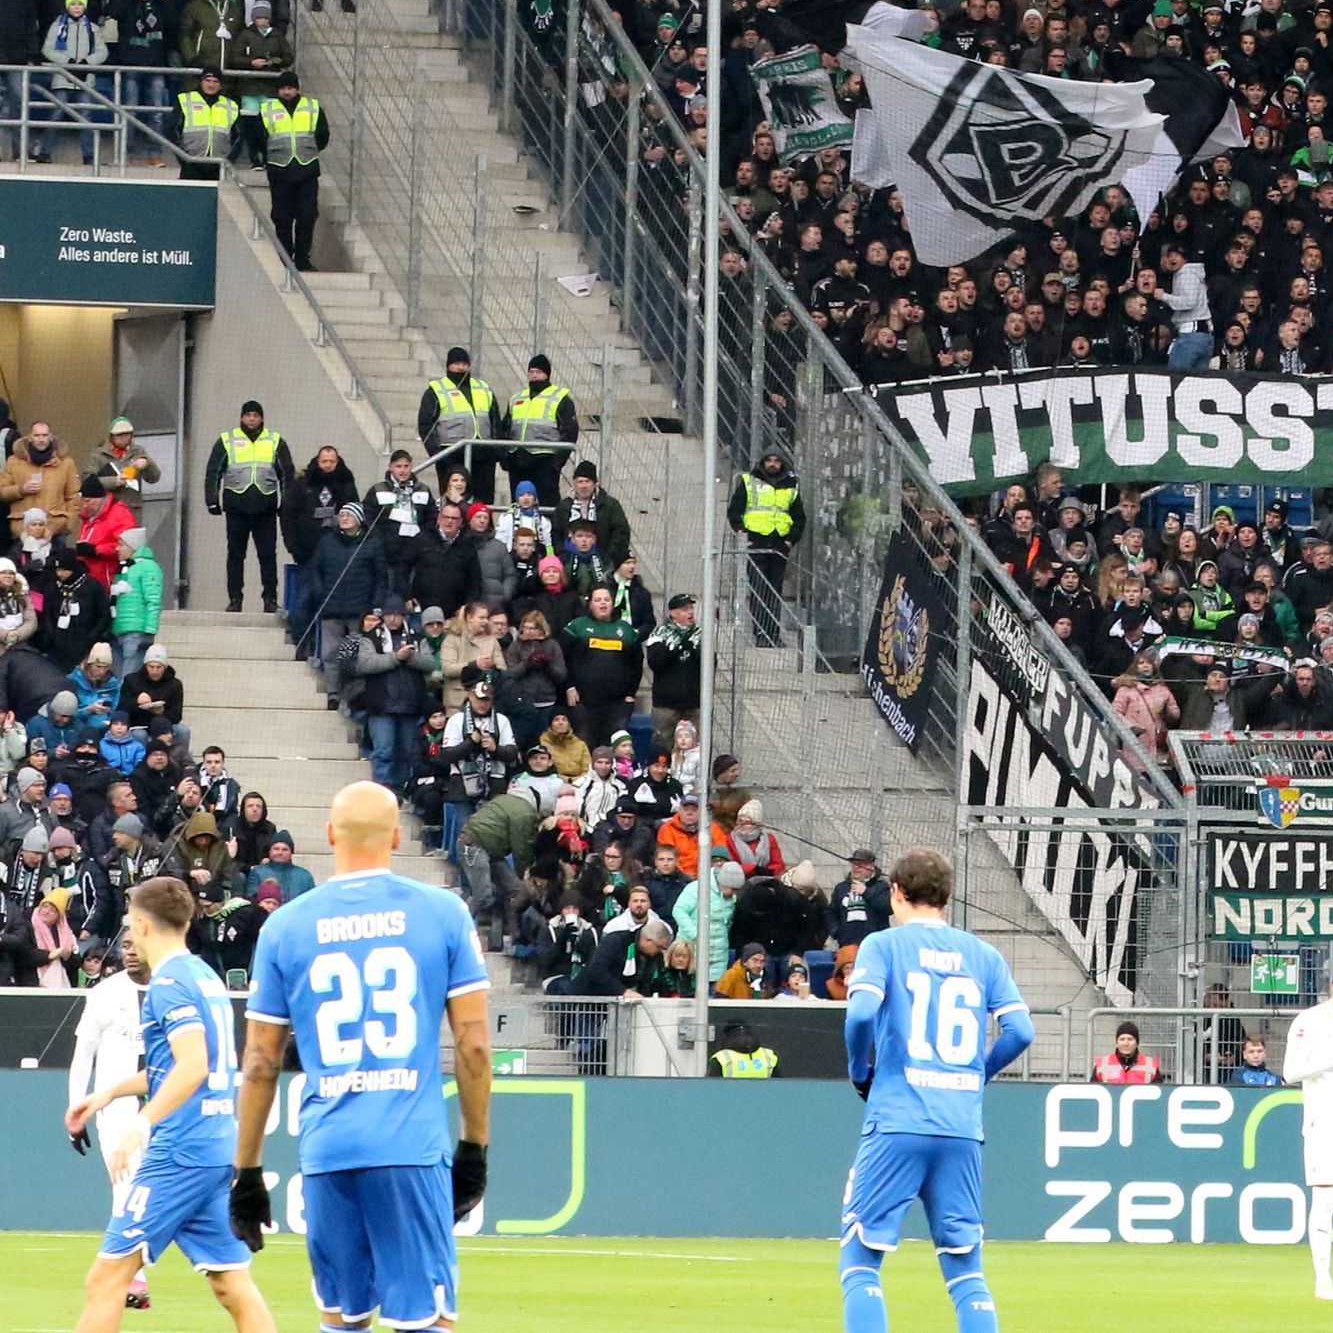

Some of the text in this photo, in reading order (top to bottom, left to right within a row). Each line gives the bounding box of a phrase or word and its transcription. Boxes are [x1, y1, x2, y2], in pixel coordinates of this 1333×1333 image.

[58, 247, 193, 266] Alles andere ist Müll.
[60, 227, 137, 244] Zero Waste.
[316, 911, 407, 945] BROOKS
[309, 946, 418, 1066] 23
[497, 1014, 507, 1033] F
[905, 972, 982, 1065] 16
[1045, 1084, 1235, 1168] pre
[1045, 1180, 1308, 1244] zero
